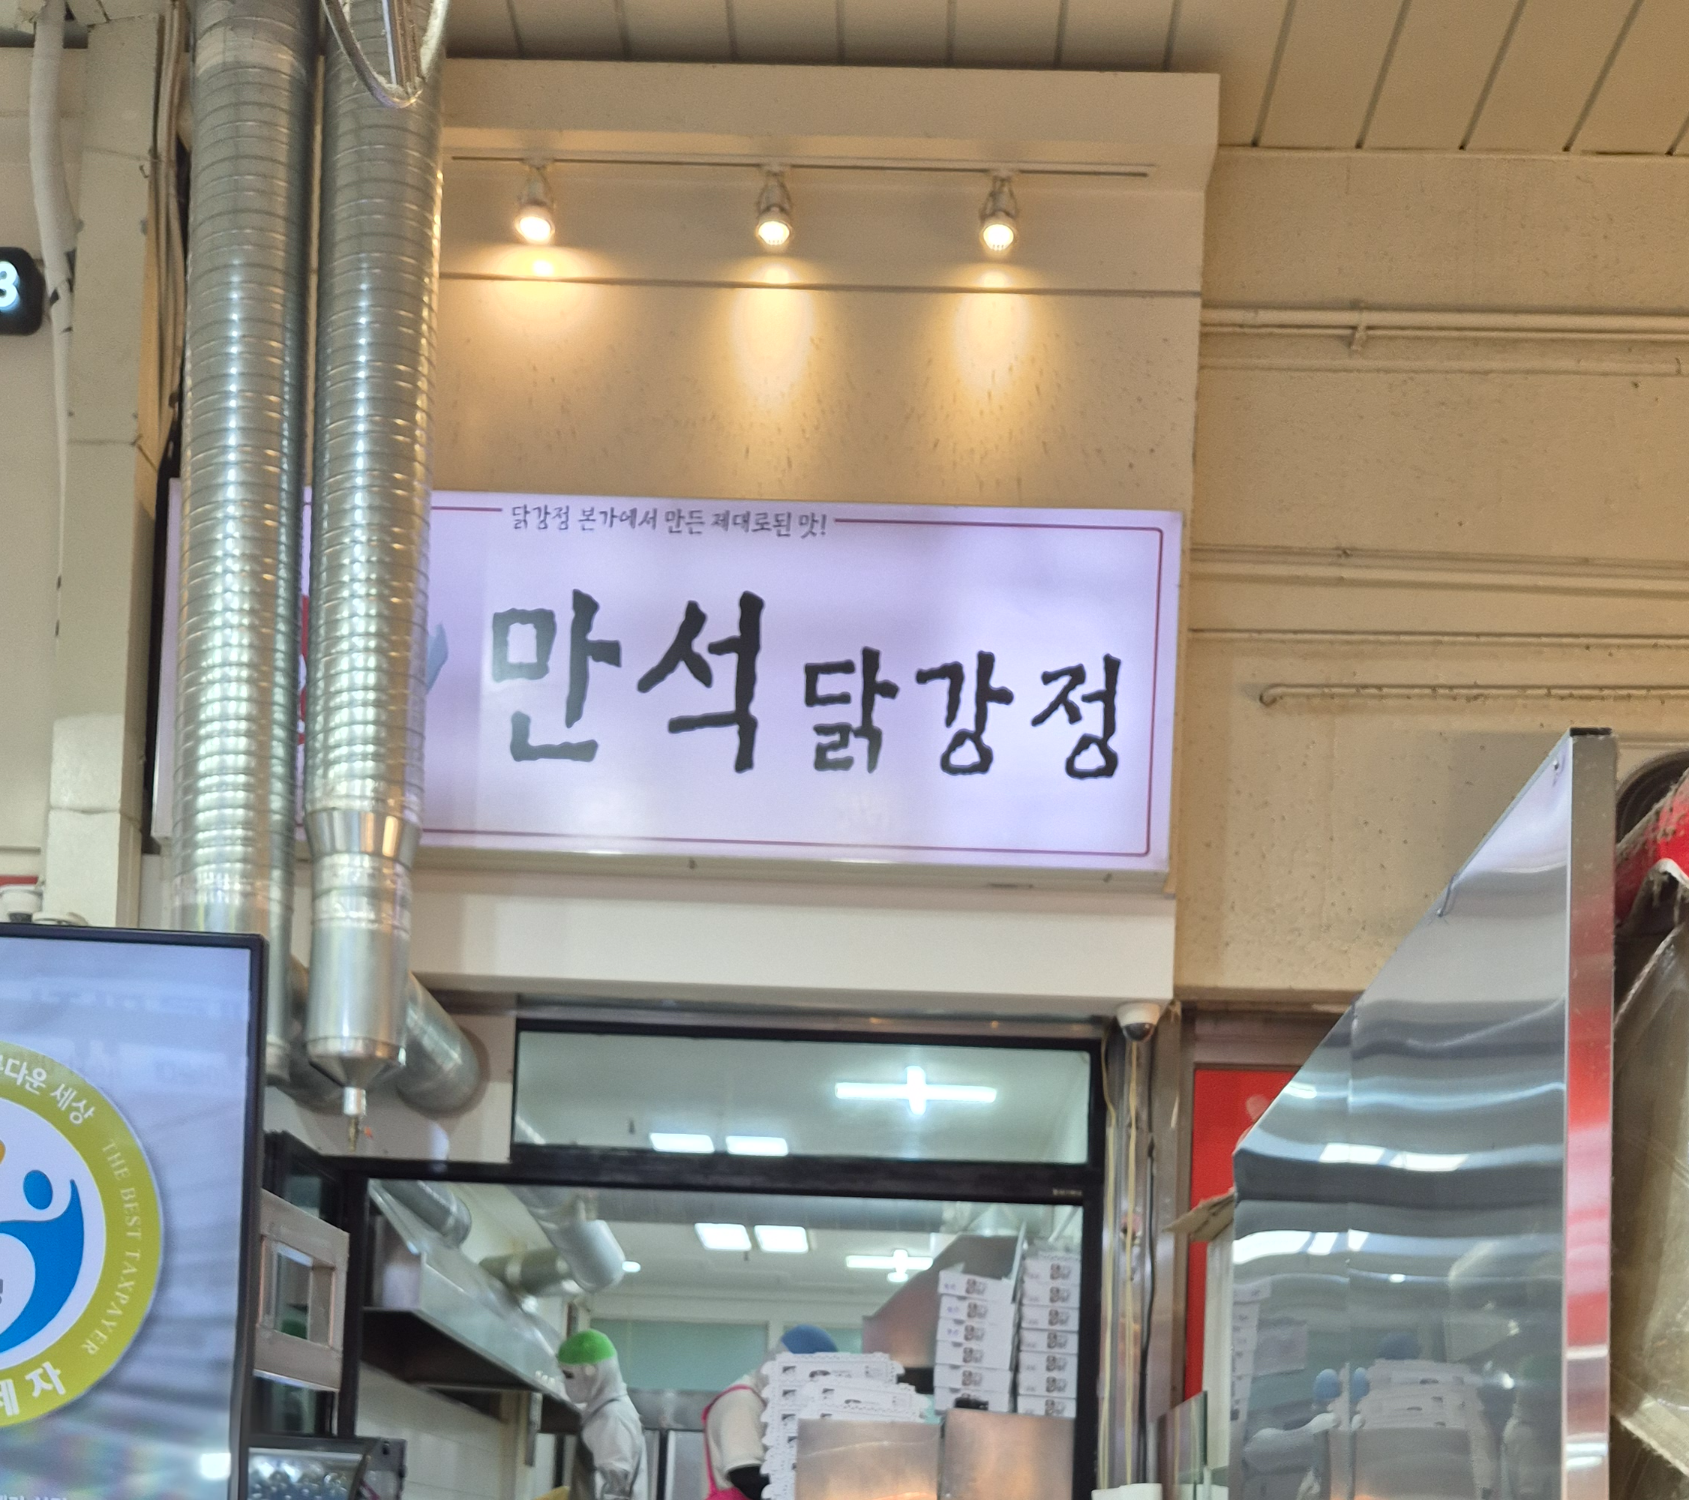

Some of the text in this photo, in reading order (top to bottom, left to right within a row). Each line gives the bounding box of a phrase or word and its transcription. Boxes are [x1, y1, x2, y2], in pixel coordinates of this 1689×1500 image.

[511, 505, 827, 539] 닭강정 본가에서 만든 제대로된 맛!
[492, 588, 1122, 780] 만석 닭강정
[51, 1083, 95, 1125] 세상
[81, 1138, 142, 1355] THE BEST TAXPAYER
